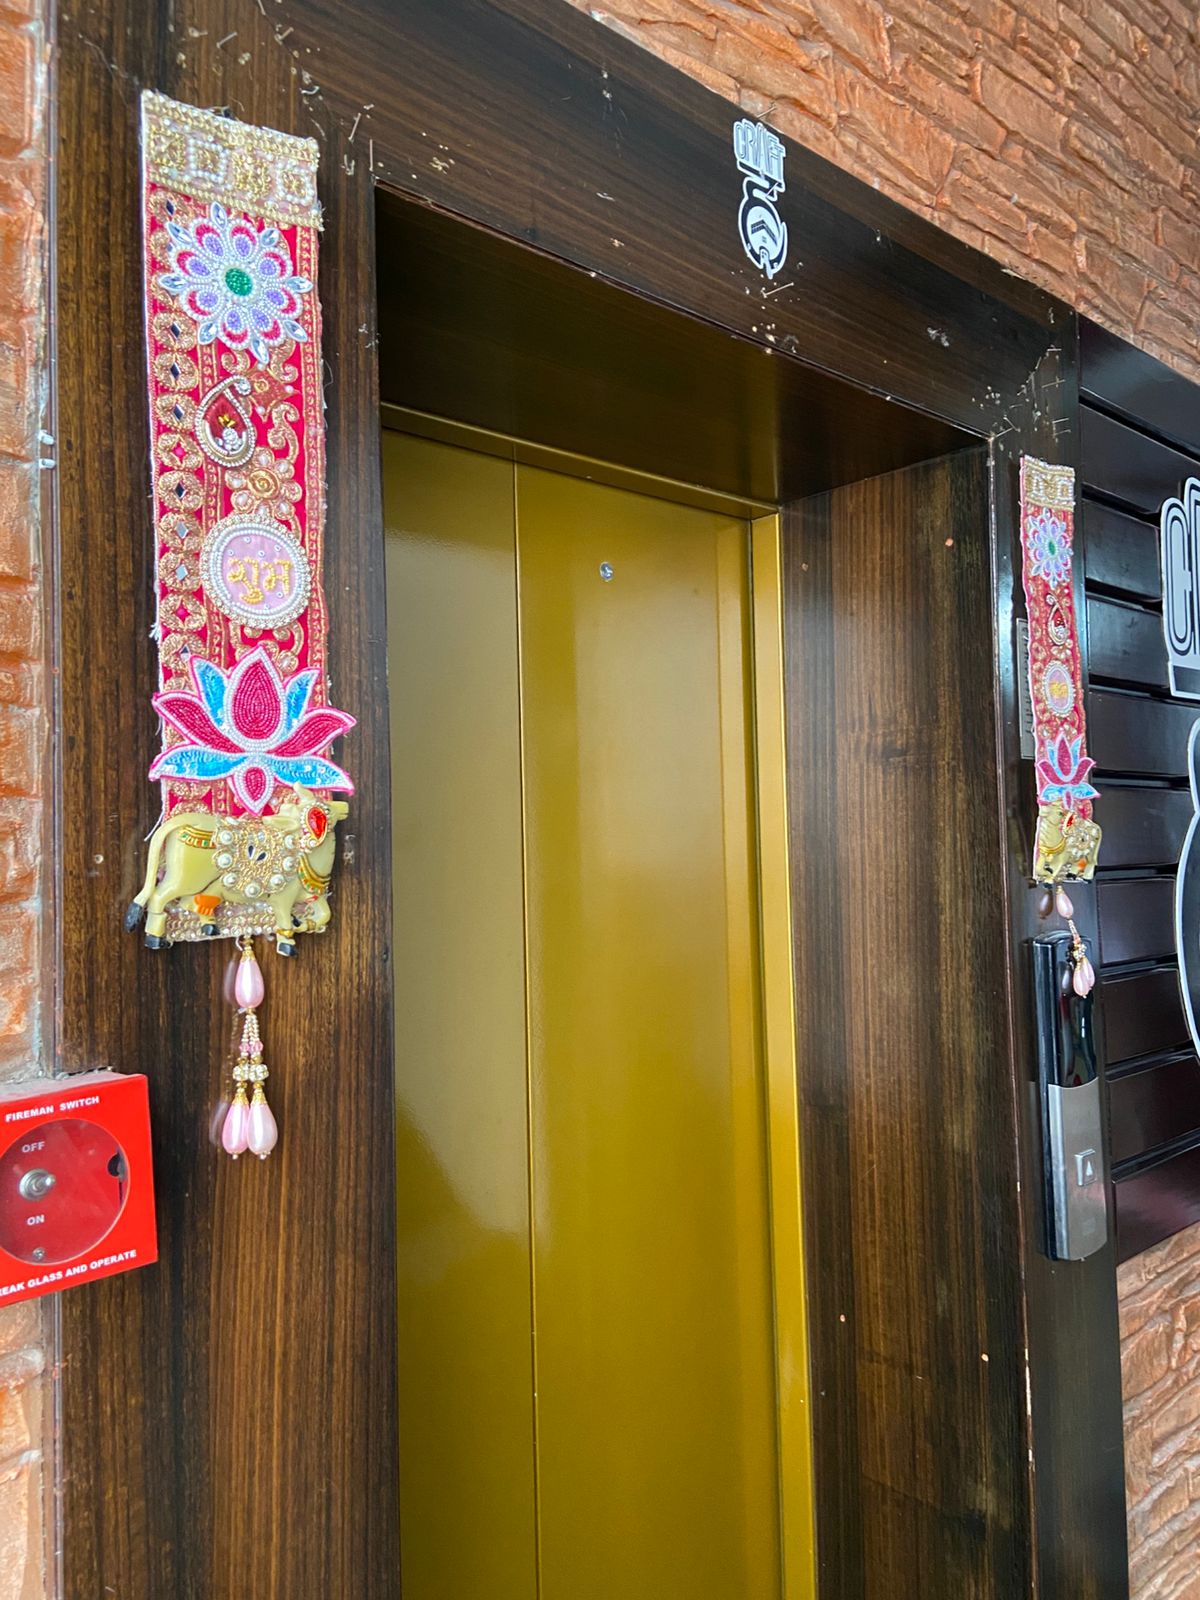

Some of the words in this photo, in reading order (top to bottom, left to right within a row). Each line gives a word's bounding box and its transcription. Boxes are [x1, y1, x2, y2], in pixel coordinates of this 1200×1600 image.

[733, 119, 786, 182] CRAFT
[5, 1105, 54, 1122] FIREMAN
[59, 1096, 100, 1111] SWITCH
[22, 1141, 45, 1153] OFF
[27, 1215, 45, 1226] ON
[27, 1271, 63, 1287] GLASS
[65, 1264, 88, 1277] AND
[90, 1249, 137, 1269] OPERATE
